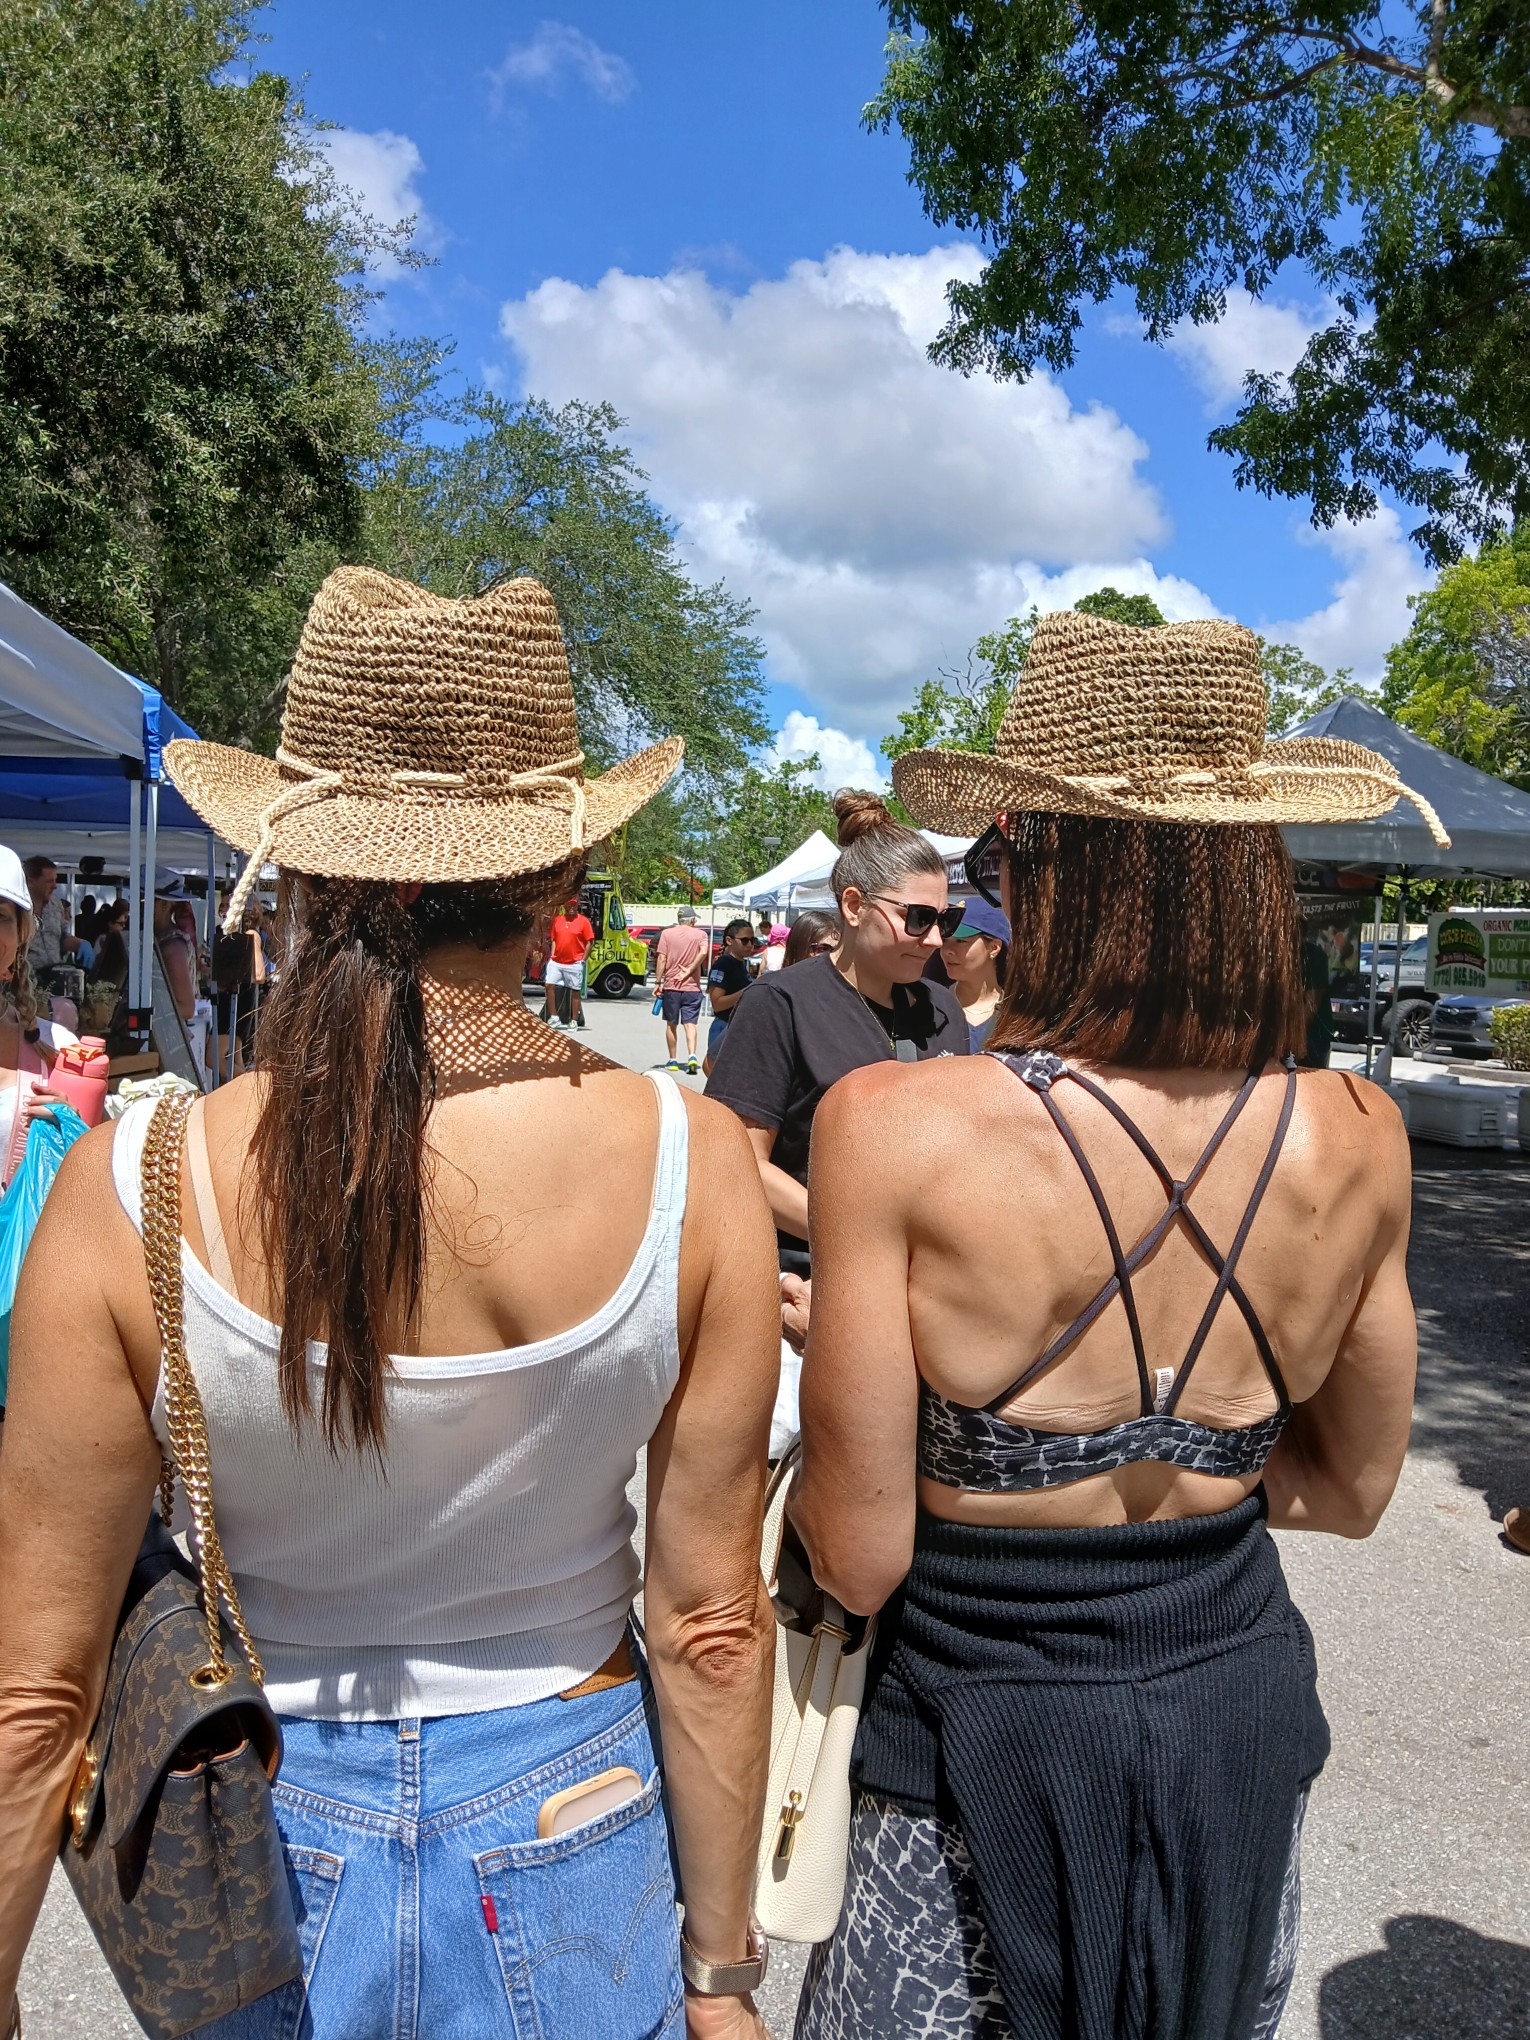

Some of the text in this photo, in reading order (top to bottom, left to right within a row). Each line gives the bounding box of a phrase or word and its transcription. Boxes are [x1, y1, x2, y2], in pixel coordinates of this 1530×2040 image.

[1303, 899, 1361, 914] TASTE THE FRUIT
[1483, 919, 1512, 931] ORGANIC
[592, 938, 614, 950] ET'S
[1498, 938, 1527, 953] DON'T
[1490, 957, 1519, 974] YOUR
